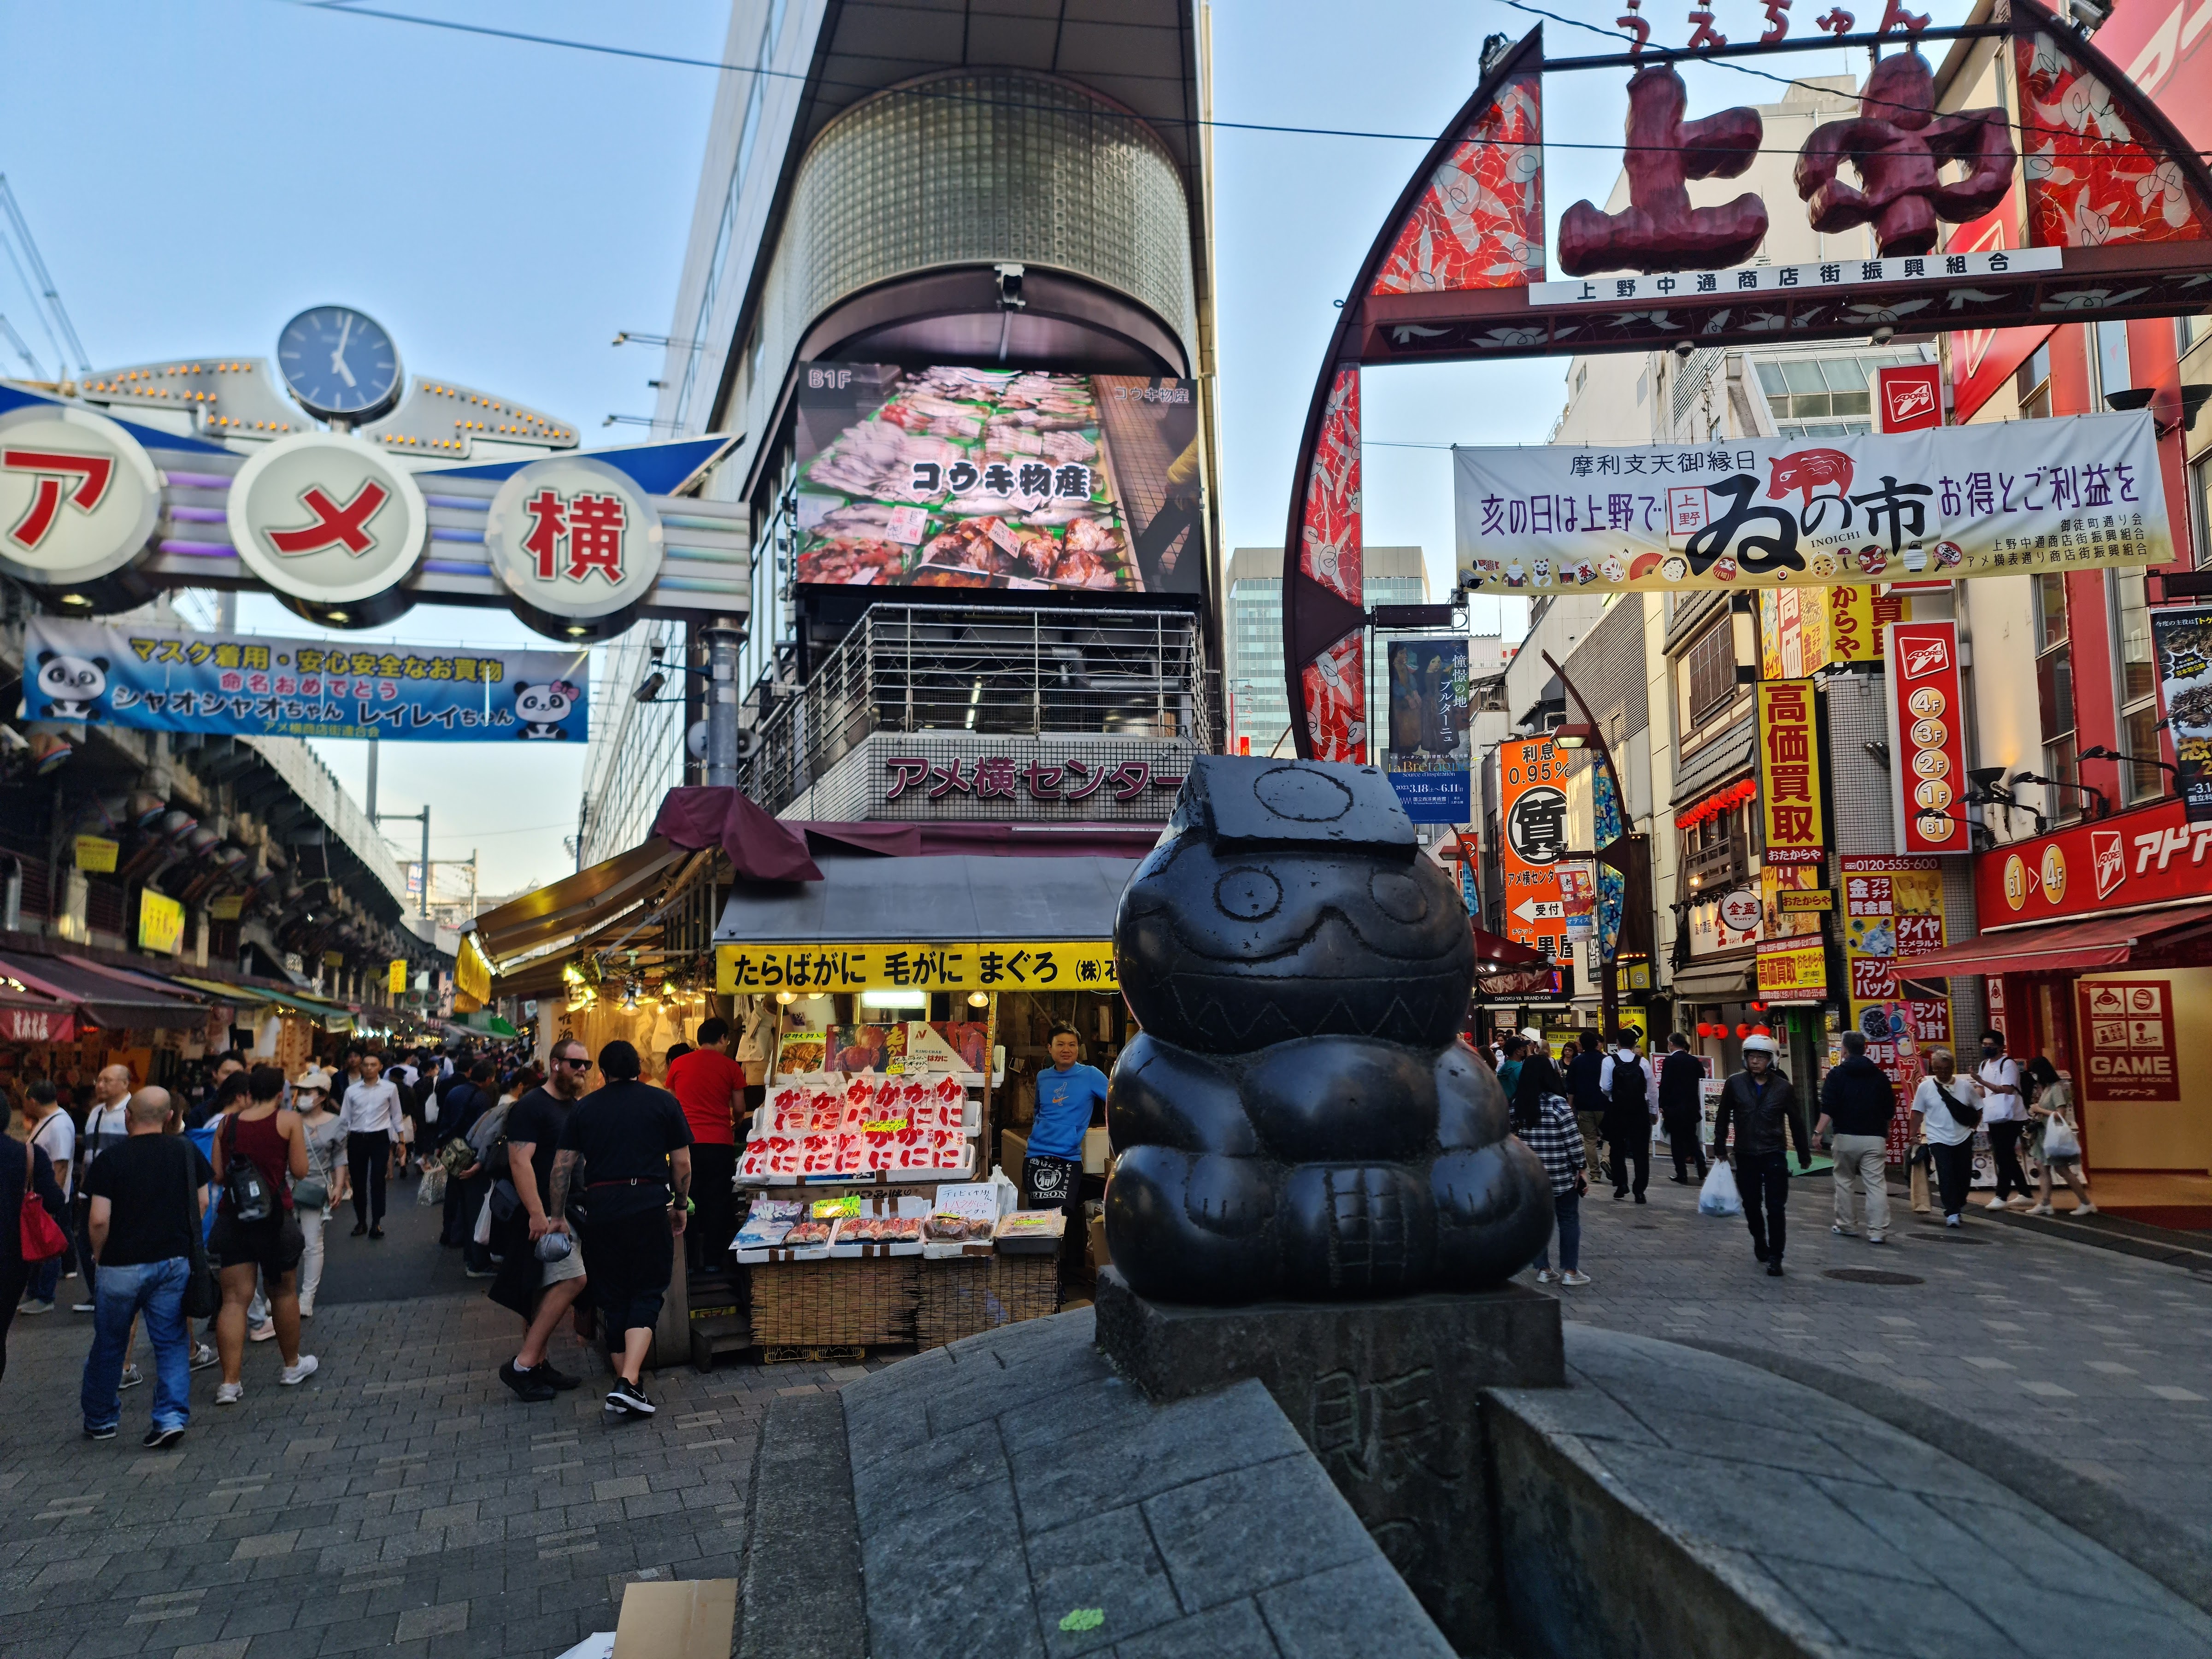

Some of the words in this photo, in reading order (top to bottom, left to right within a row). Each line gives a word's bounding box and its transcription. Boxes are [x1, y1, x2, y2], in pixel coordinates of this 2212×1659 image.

[1576, 251, 2010, 301] 上野中通商店街振興組合
[808, 369, 853, 389] B1F
[1114, 385, 1189, 406] コウキ物産
[1893, 392, 1930, 404] ADORES
[1570, 450, 1755, 477] 摩利支天御縁日
[912, 461, 1091, 501] コウキ物産
[1938, 462, 2140, 518] お得とご利益を
[0, 446, 628, 587] アメ横
[1480, 492, 1662, 536] 亥の日は上野で
[1677, 494, 1701, 527] 上野
[2060, 512, 2143, 532] 御徒町通り会
[1811, 530, 1861, 548] INOICHI
[1994, 527, 2146, 551] 上野中通商店街振興組合
[1966, 542, 2148, 568] アメ横表通り商店街振興組合
[129, 636, 505, 682] マスク着用・安心安全なお買物
[1805, 648, 1822, 673] 貴金属
[1907, 649, 1944, 660] ADORES
[2176, 663, 2206, 677] 日本初公開
[218, 671, 398, 700] 命名おめでとう
[1452, 654, 1468, 709] 憧憬の地
[111, 685, 344, 724] シャオシャオちゃん
[358, 702, 515, 729] レイレイちゃん
[1438, 679, 1453, 743] ブルターニュ
[1914, 694, 1940, 713] 4F
[1917, 724, 1942, 743] 3F
[1522, 743, 1555, 764] 利息
[2177, 736, 2212, 761] 恐
[1403, 761, 1471, 772] Bretagne
[1508, 761, 1569, 786] 0.95%
[1765, 683, 1816, 844] 高価買取
[1919, 754, 1944, 774] 2F
[887, 756, 1186, 800] アメ横センター
[1923, 785, 1947, 803] 1F
[1516, 795, 1567, 856] 質
[1924, 818, 1945, 834] B1
[1768, 849, 1822, 862] おたからや
[1856, 859, 1938, 871] 0120-555-600
[2097, 851, 2121, 868] ADORES
[1507, 870, 1558, 887] アメ横センタ
[1871, 878, 1889, 888] プラ
[2008, 865, 2023, 897] B1
[2046, 858, 2063, 890] 4F
[1848, 878, 1869, 898] 金
[1871, 888, 1891, 899] チナ
[1535, 903, 1559, 917] 受付
[1783, 895, 1831, 906] おたからや
[1849, 900, 1893, 915] 貴金属
[1512, 927, 1534, 935] チケット
[1897, 918, 1940, 939] ダイヤ
[734, 950, 867, 988] たらばがに
[883, 951, 965, 984] 毛がに
[979, 950, 1059, 984] まぐろ
[1797, 952, 1824, 970] おたからや
[1758, 956, 1797, 987] 高価買取
[1802, 988, 1827, 997] 0120-555-600
[1856, 979, 1895, 997] バッグ
[1910, 1001, 1947, 1019] ランド
[1866, 1044, 1895, 1064] 切手
[2089, 1056, 2172, 1075] GAME
